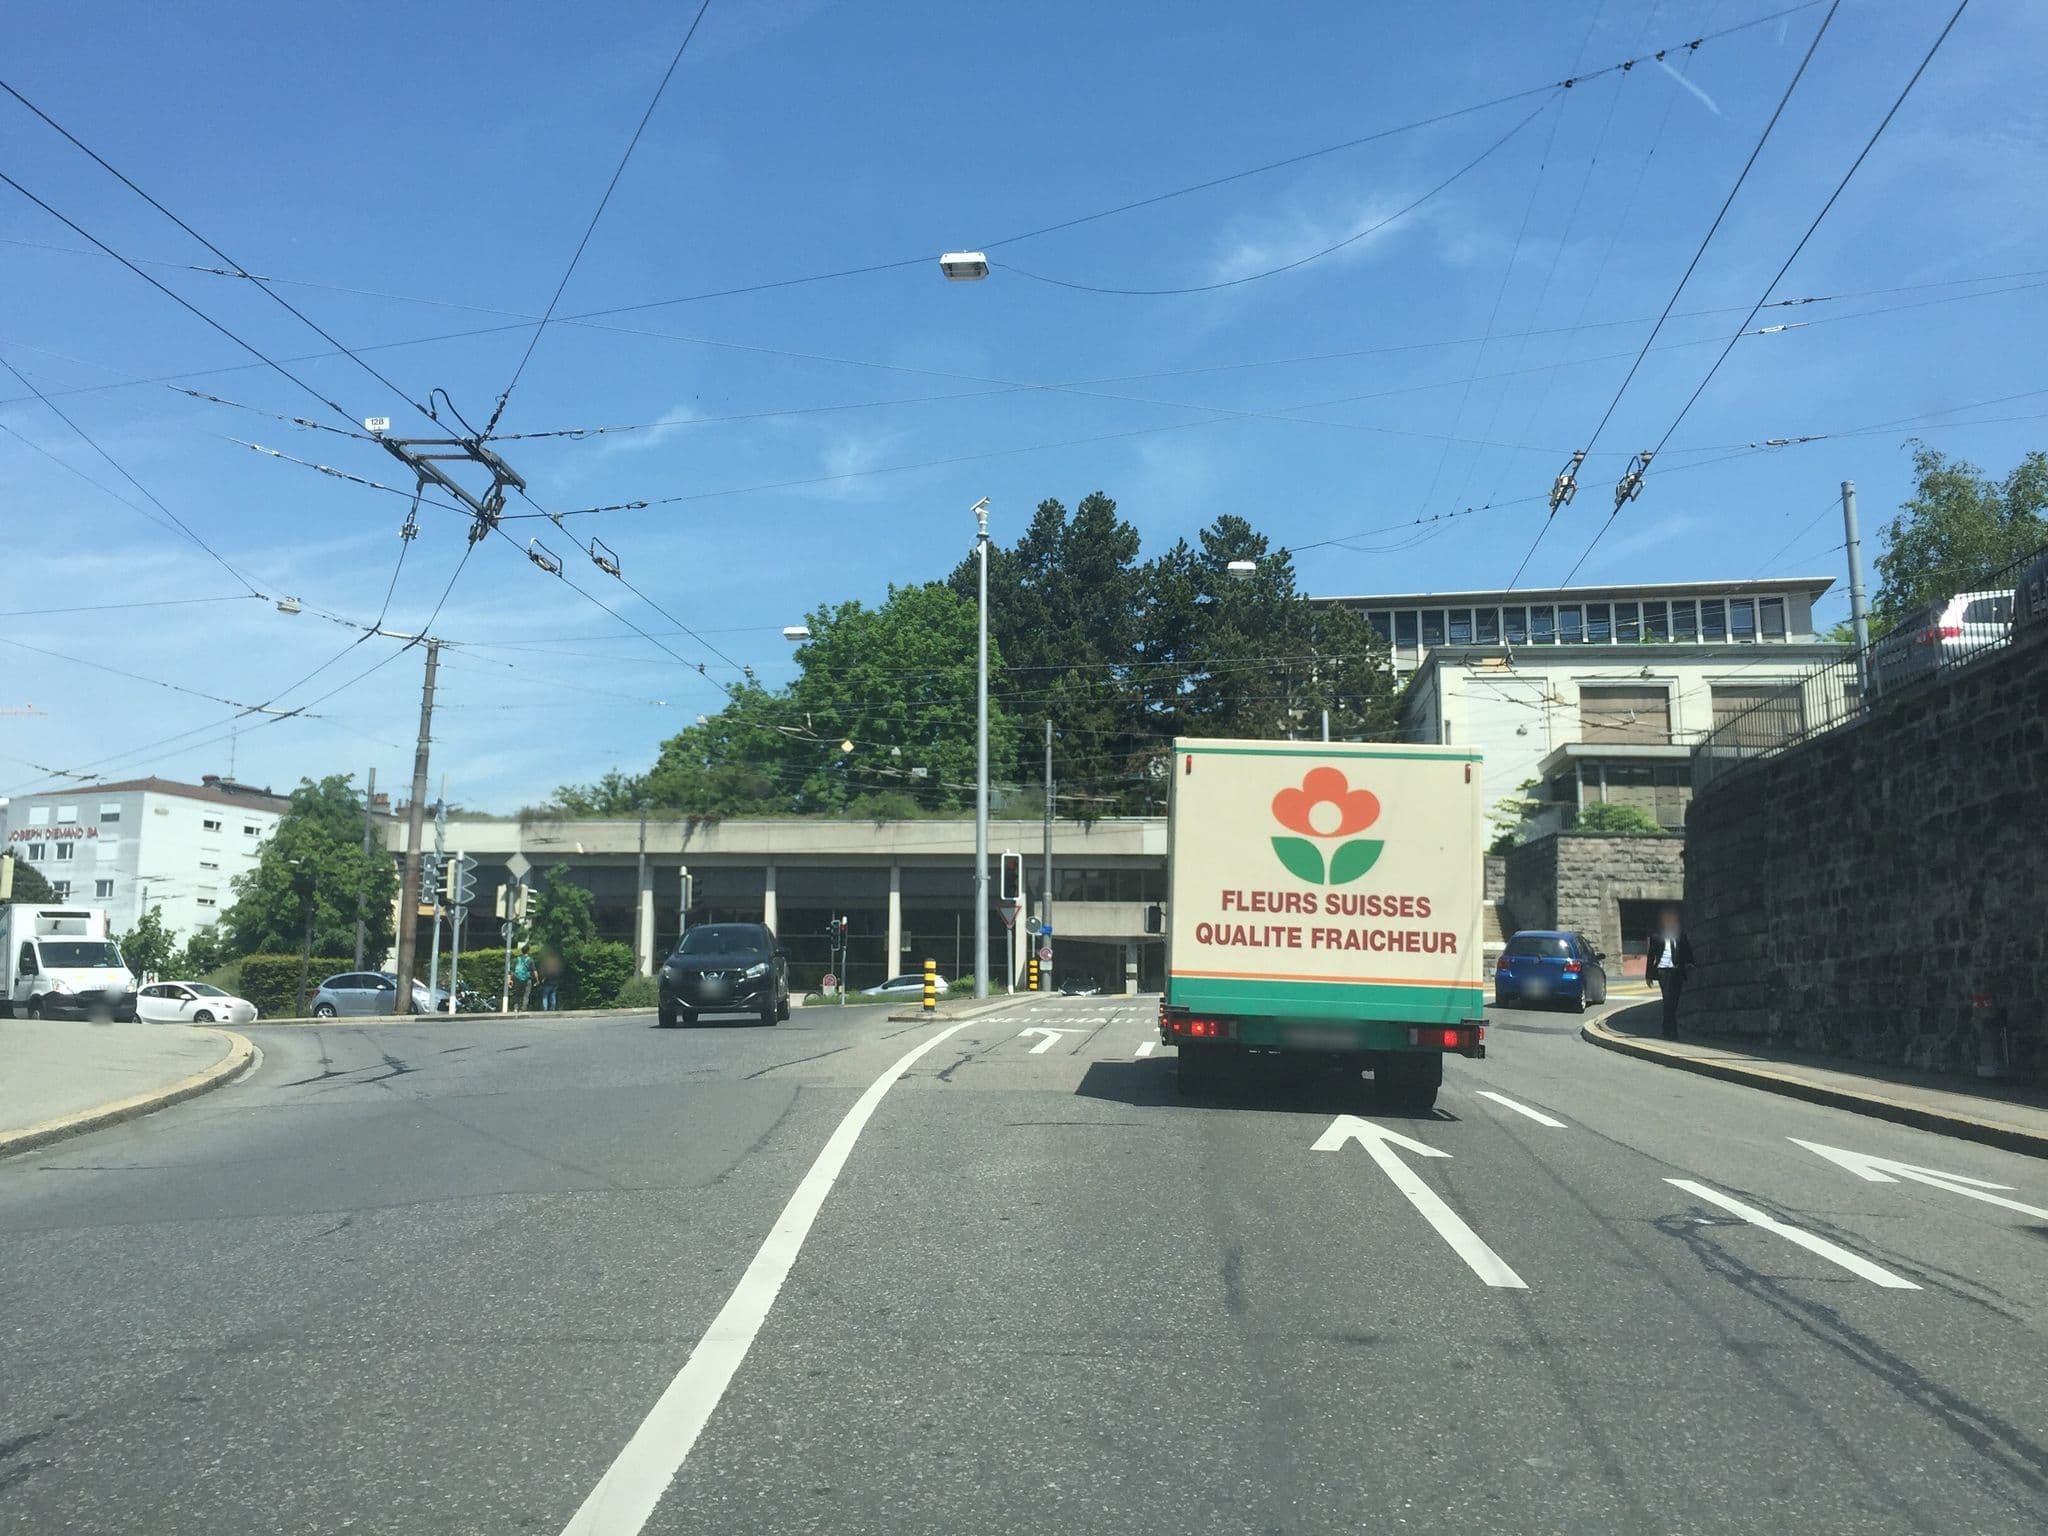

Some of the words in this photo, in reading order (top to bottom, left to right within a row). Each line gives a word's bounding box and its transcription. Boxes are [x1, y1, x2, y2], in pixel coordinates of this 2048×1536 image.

[8, 828, 42, 842] JOSEPH
[87, 825, 99, 839] SA
[1221, 890, 1318, 915] FLEURS
[1325, 893, 1432, 918] SUISSES
[1195, 922, 1303, 948] QUALITE
[1311, 927, 1458, 954] FRAICHEUR
